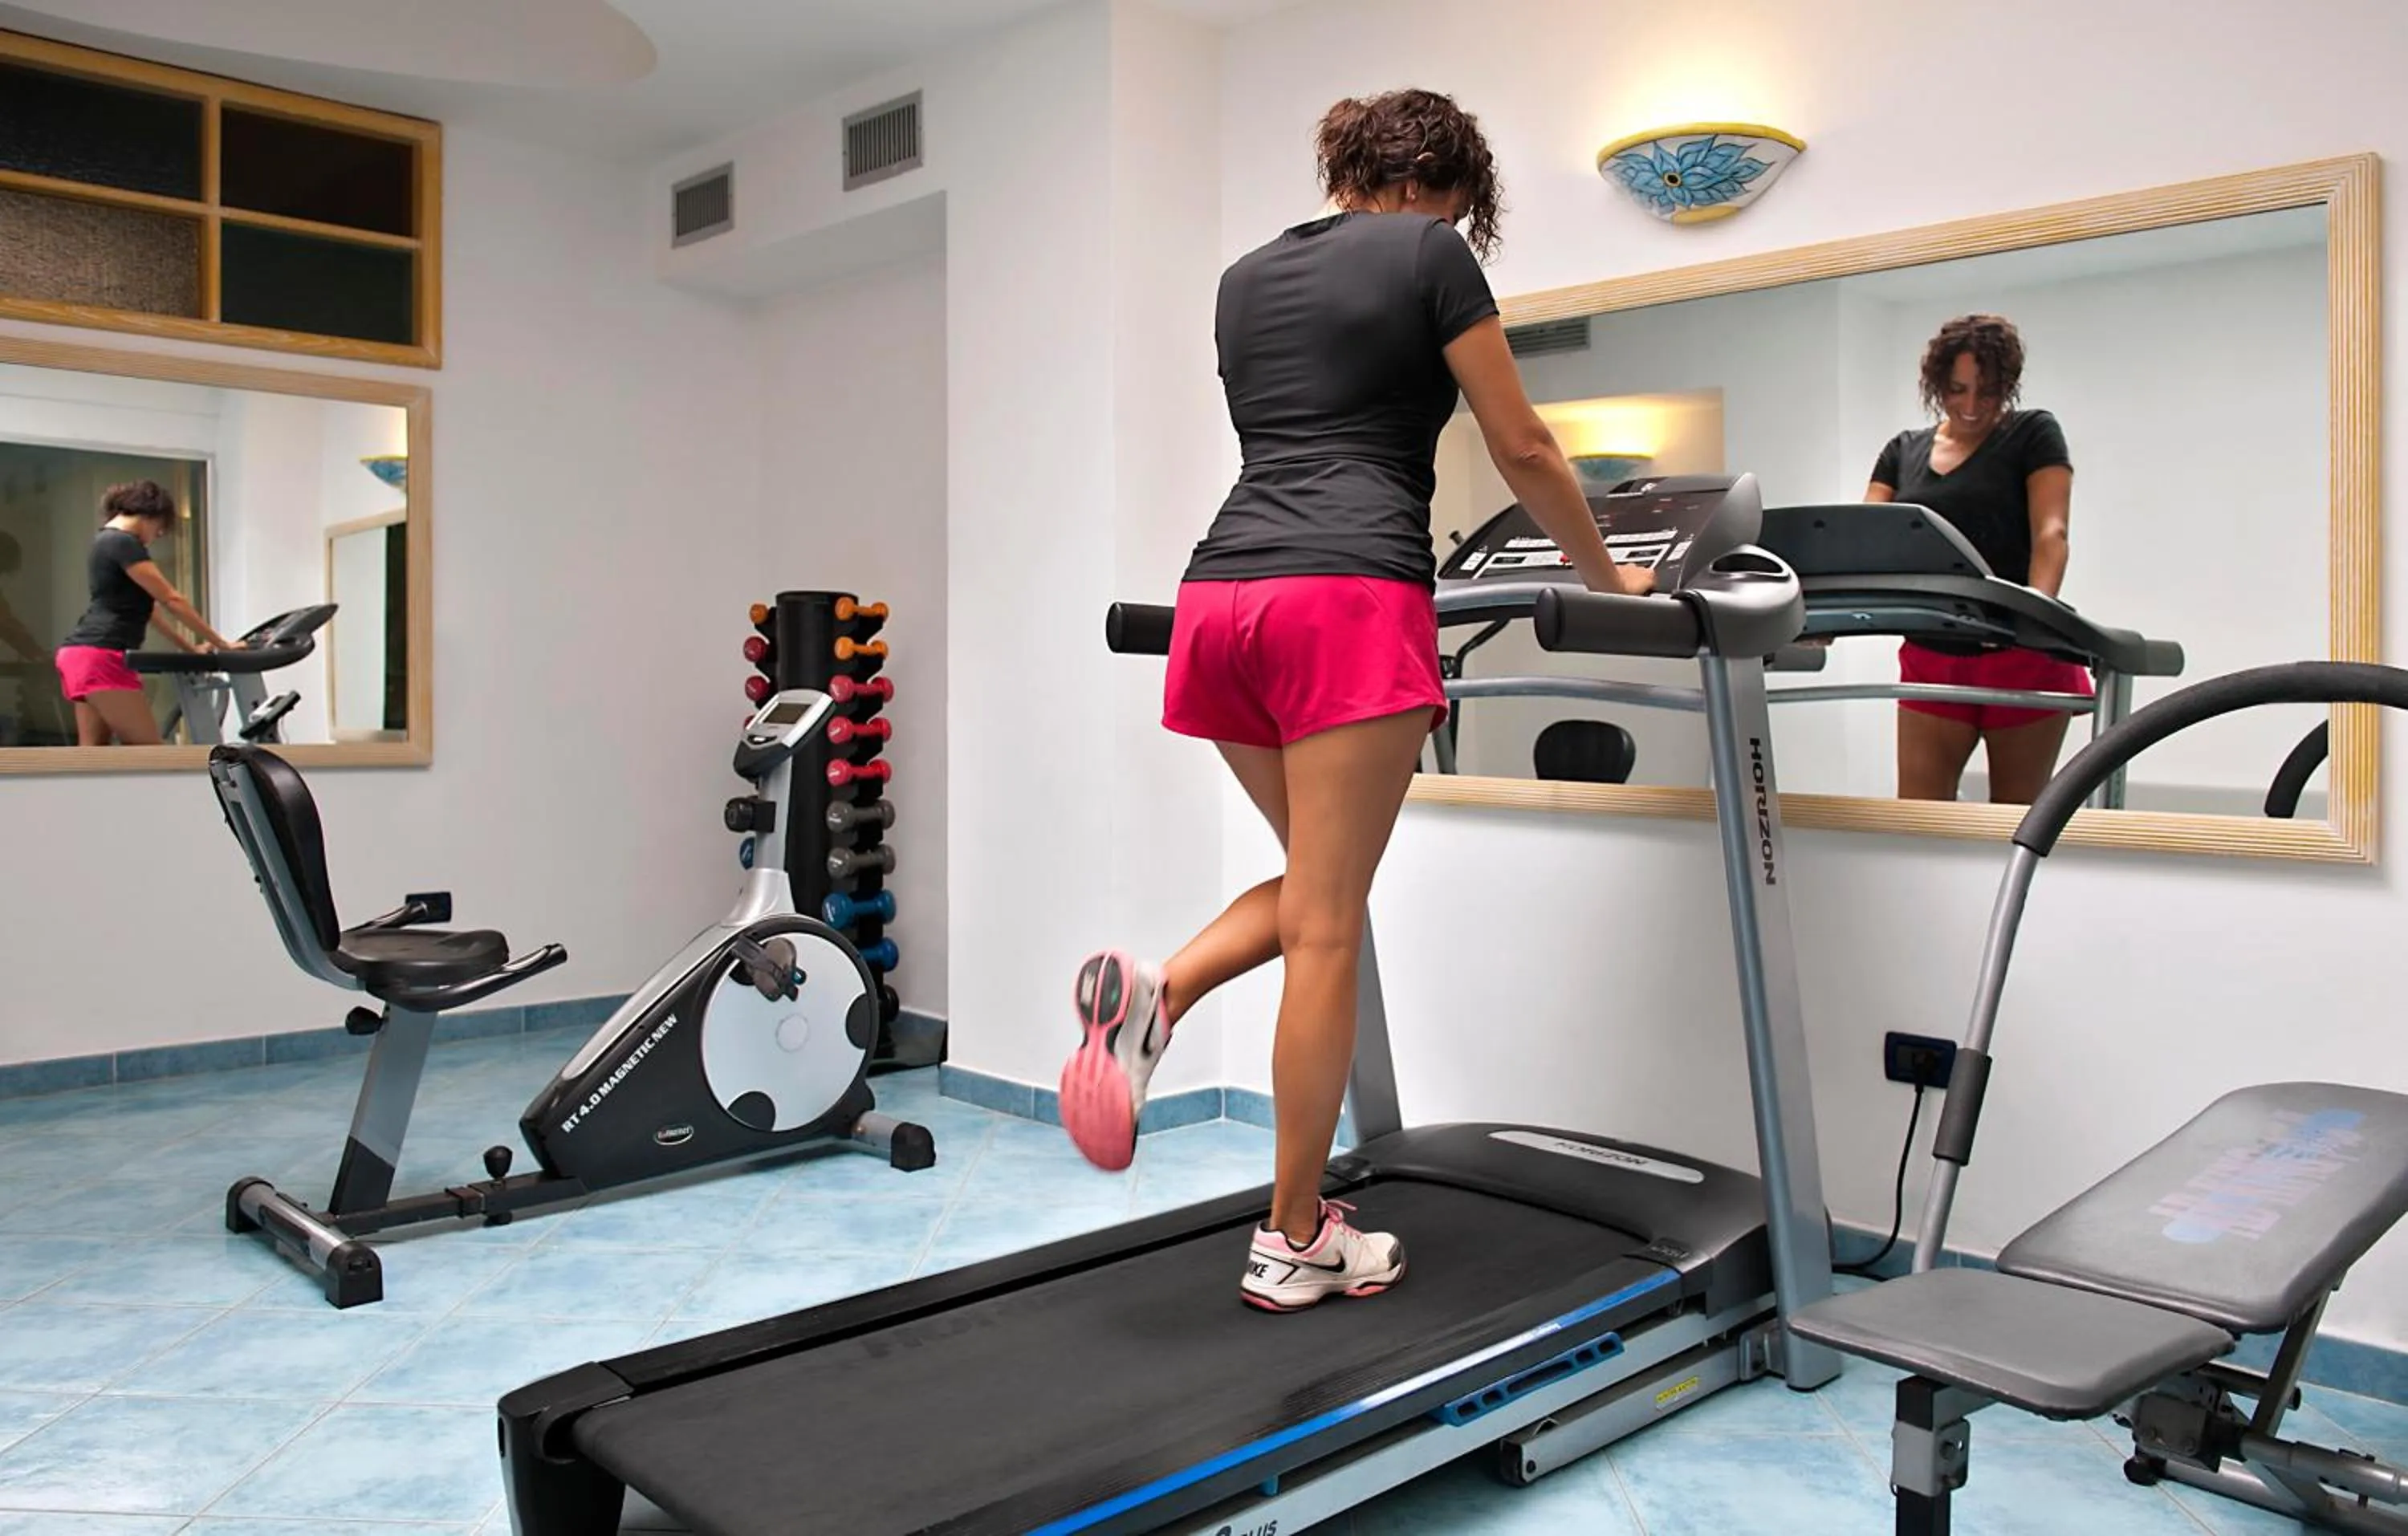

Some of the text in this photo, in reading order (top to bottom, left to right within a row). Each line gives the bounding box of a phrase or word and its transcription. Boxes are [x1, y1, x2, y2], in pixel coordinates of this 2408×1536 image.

[1749, 738, 1776, 885] HORIZON
[560, 1014, 678, 1133] RT 4.0 MAGNETIC NEW
[1241, 1519, 1278, 1536] US
